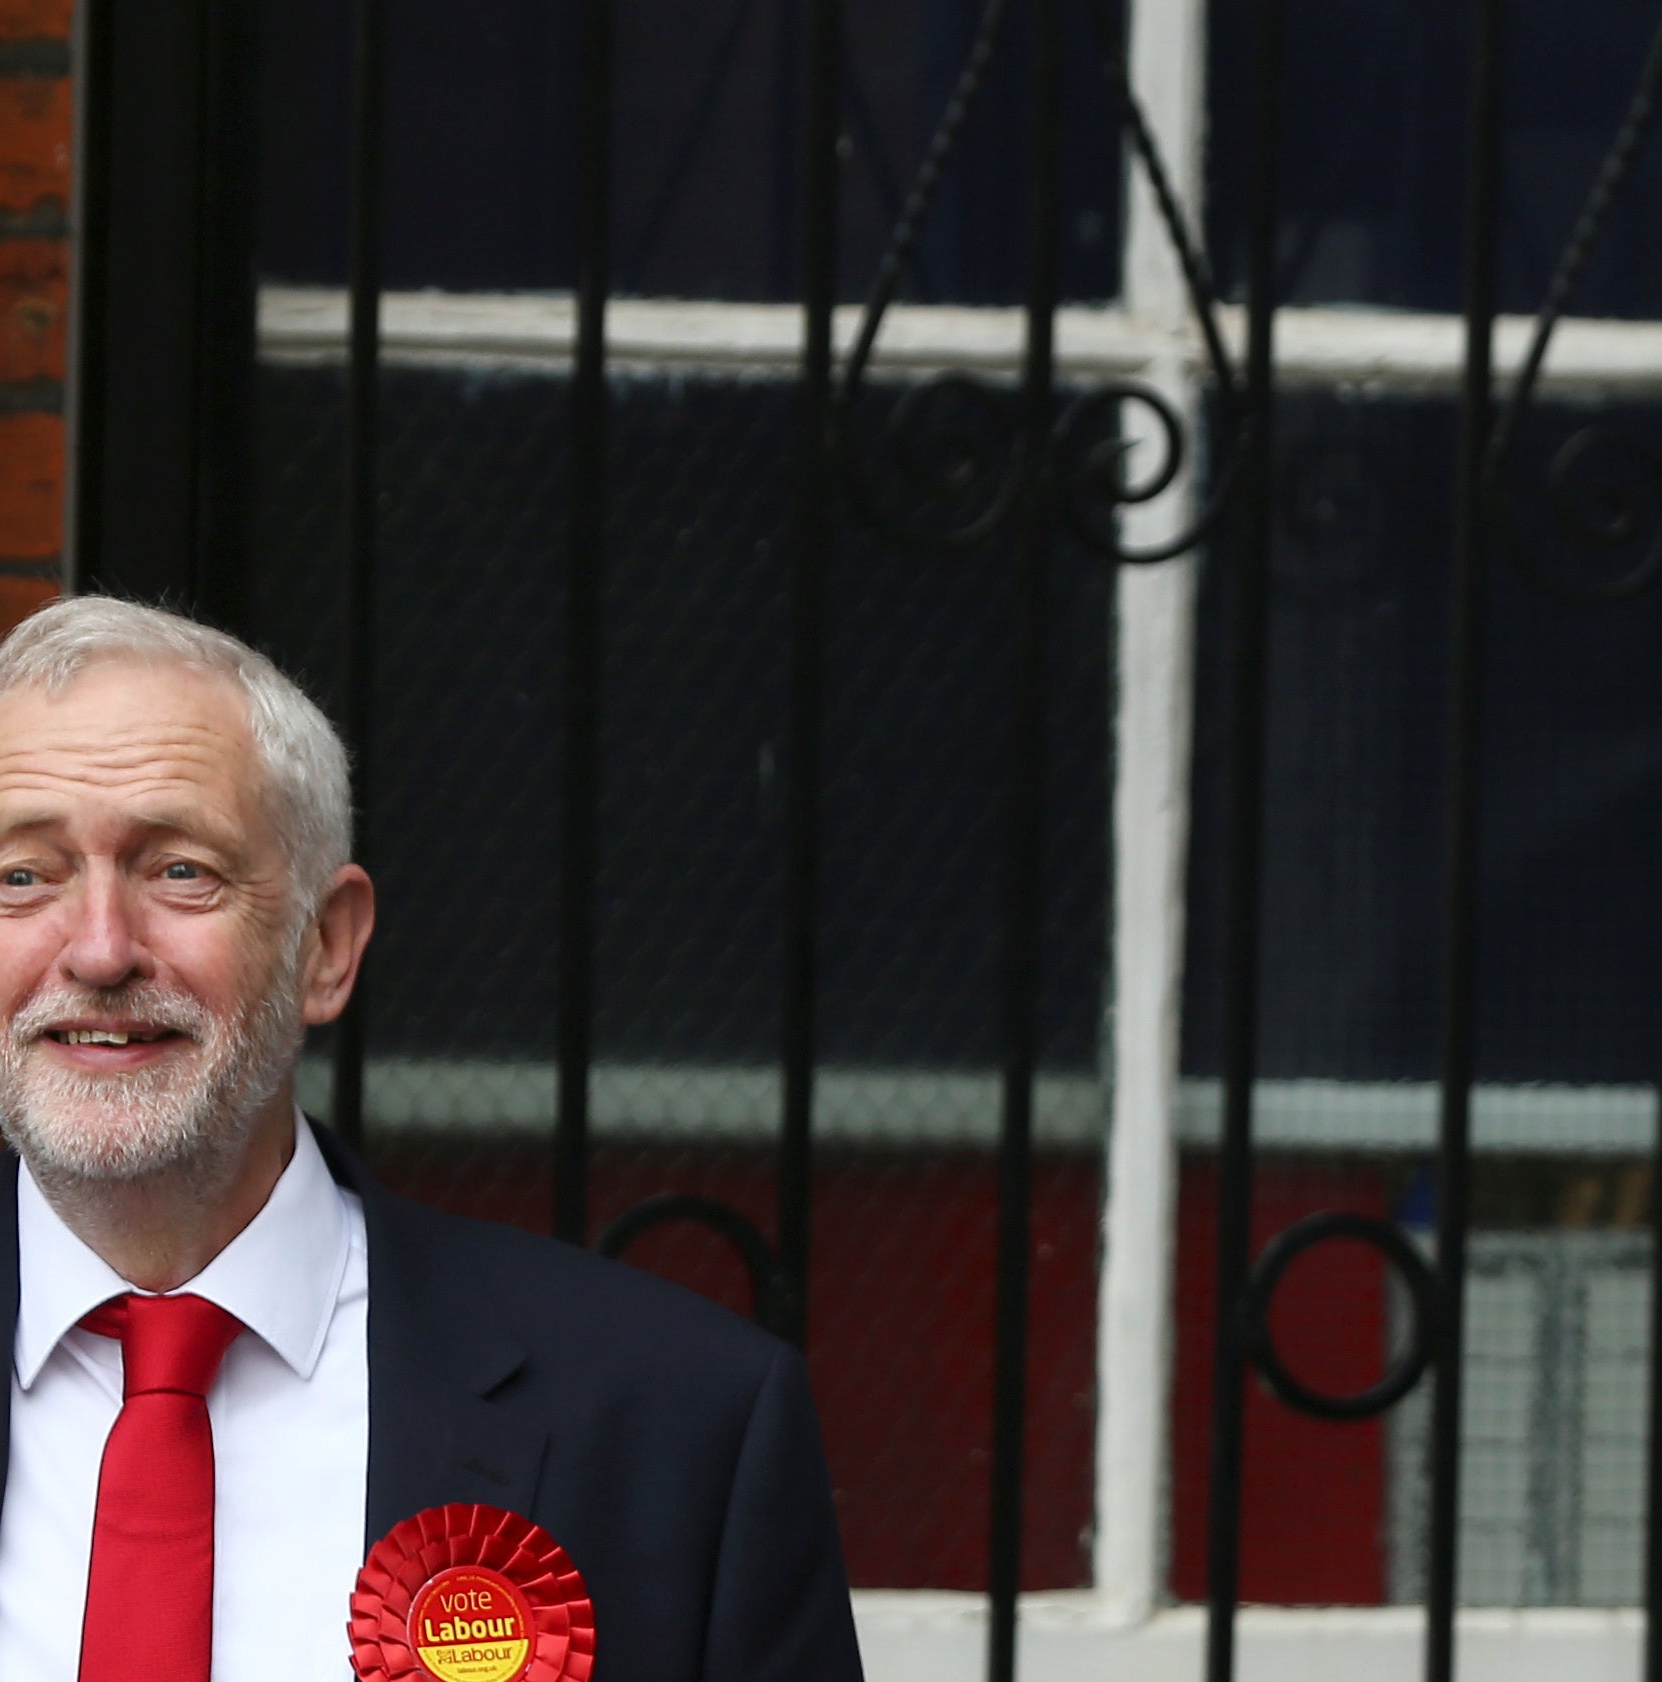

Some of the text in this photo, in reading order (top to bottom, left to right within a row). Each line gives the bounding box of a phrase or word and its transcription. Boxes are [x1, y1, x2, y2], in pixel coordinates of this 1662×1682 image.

[440, 1588, 492, 1613] vote
[424, 1616, 515, 1642] Labour
[453, 1646, 513, 1664] Labour
